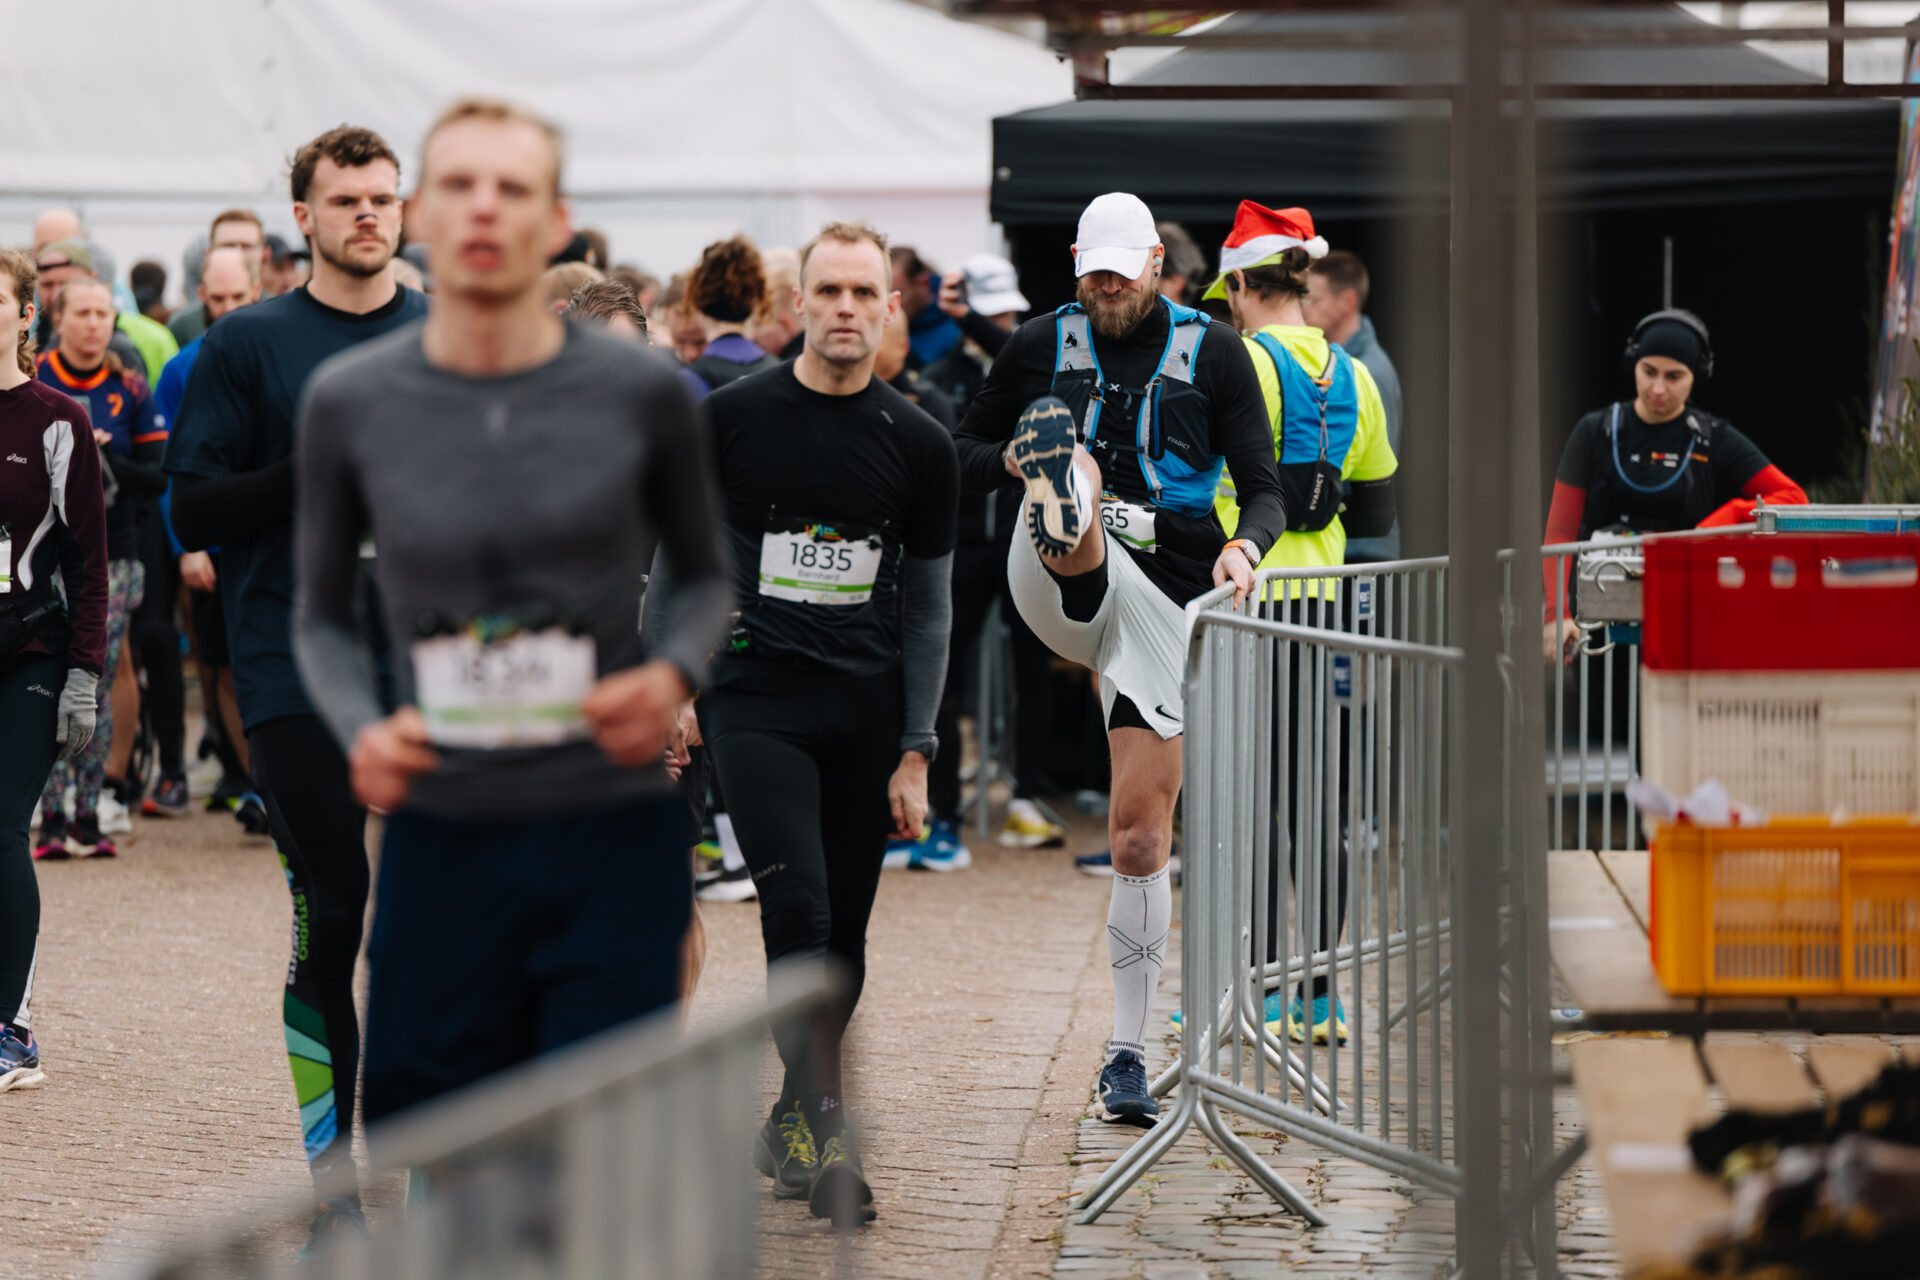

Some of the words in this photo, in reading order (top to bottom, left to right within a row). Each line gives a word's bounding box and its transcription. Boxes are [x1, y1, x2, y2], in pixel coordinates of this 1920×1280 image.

[1167, 436, 1191, 450] EVADICT
[1309, 472, 1324, 510] EVADICT
[790, 542, 853, 571] 1835
[295, 893, 309, 961] STUDIO
